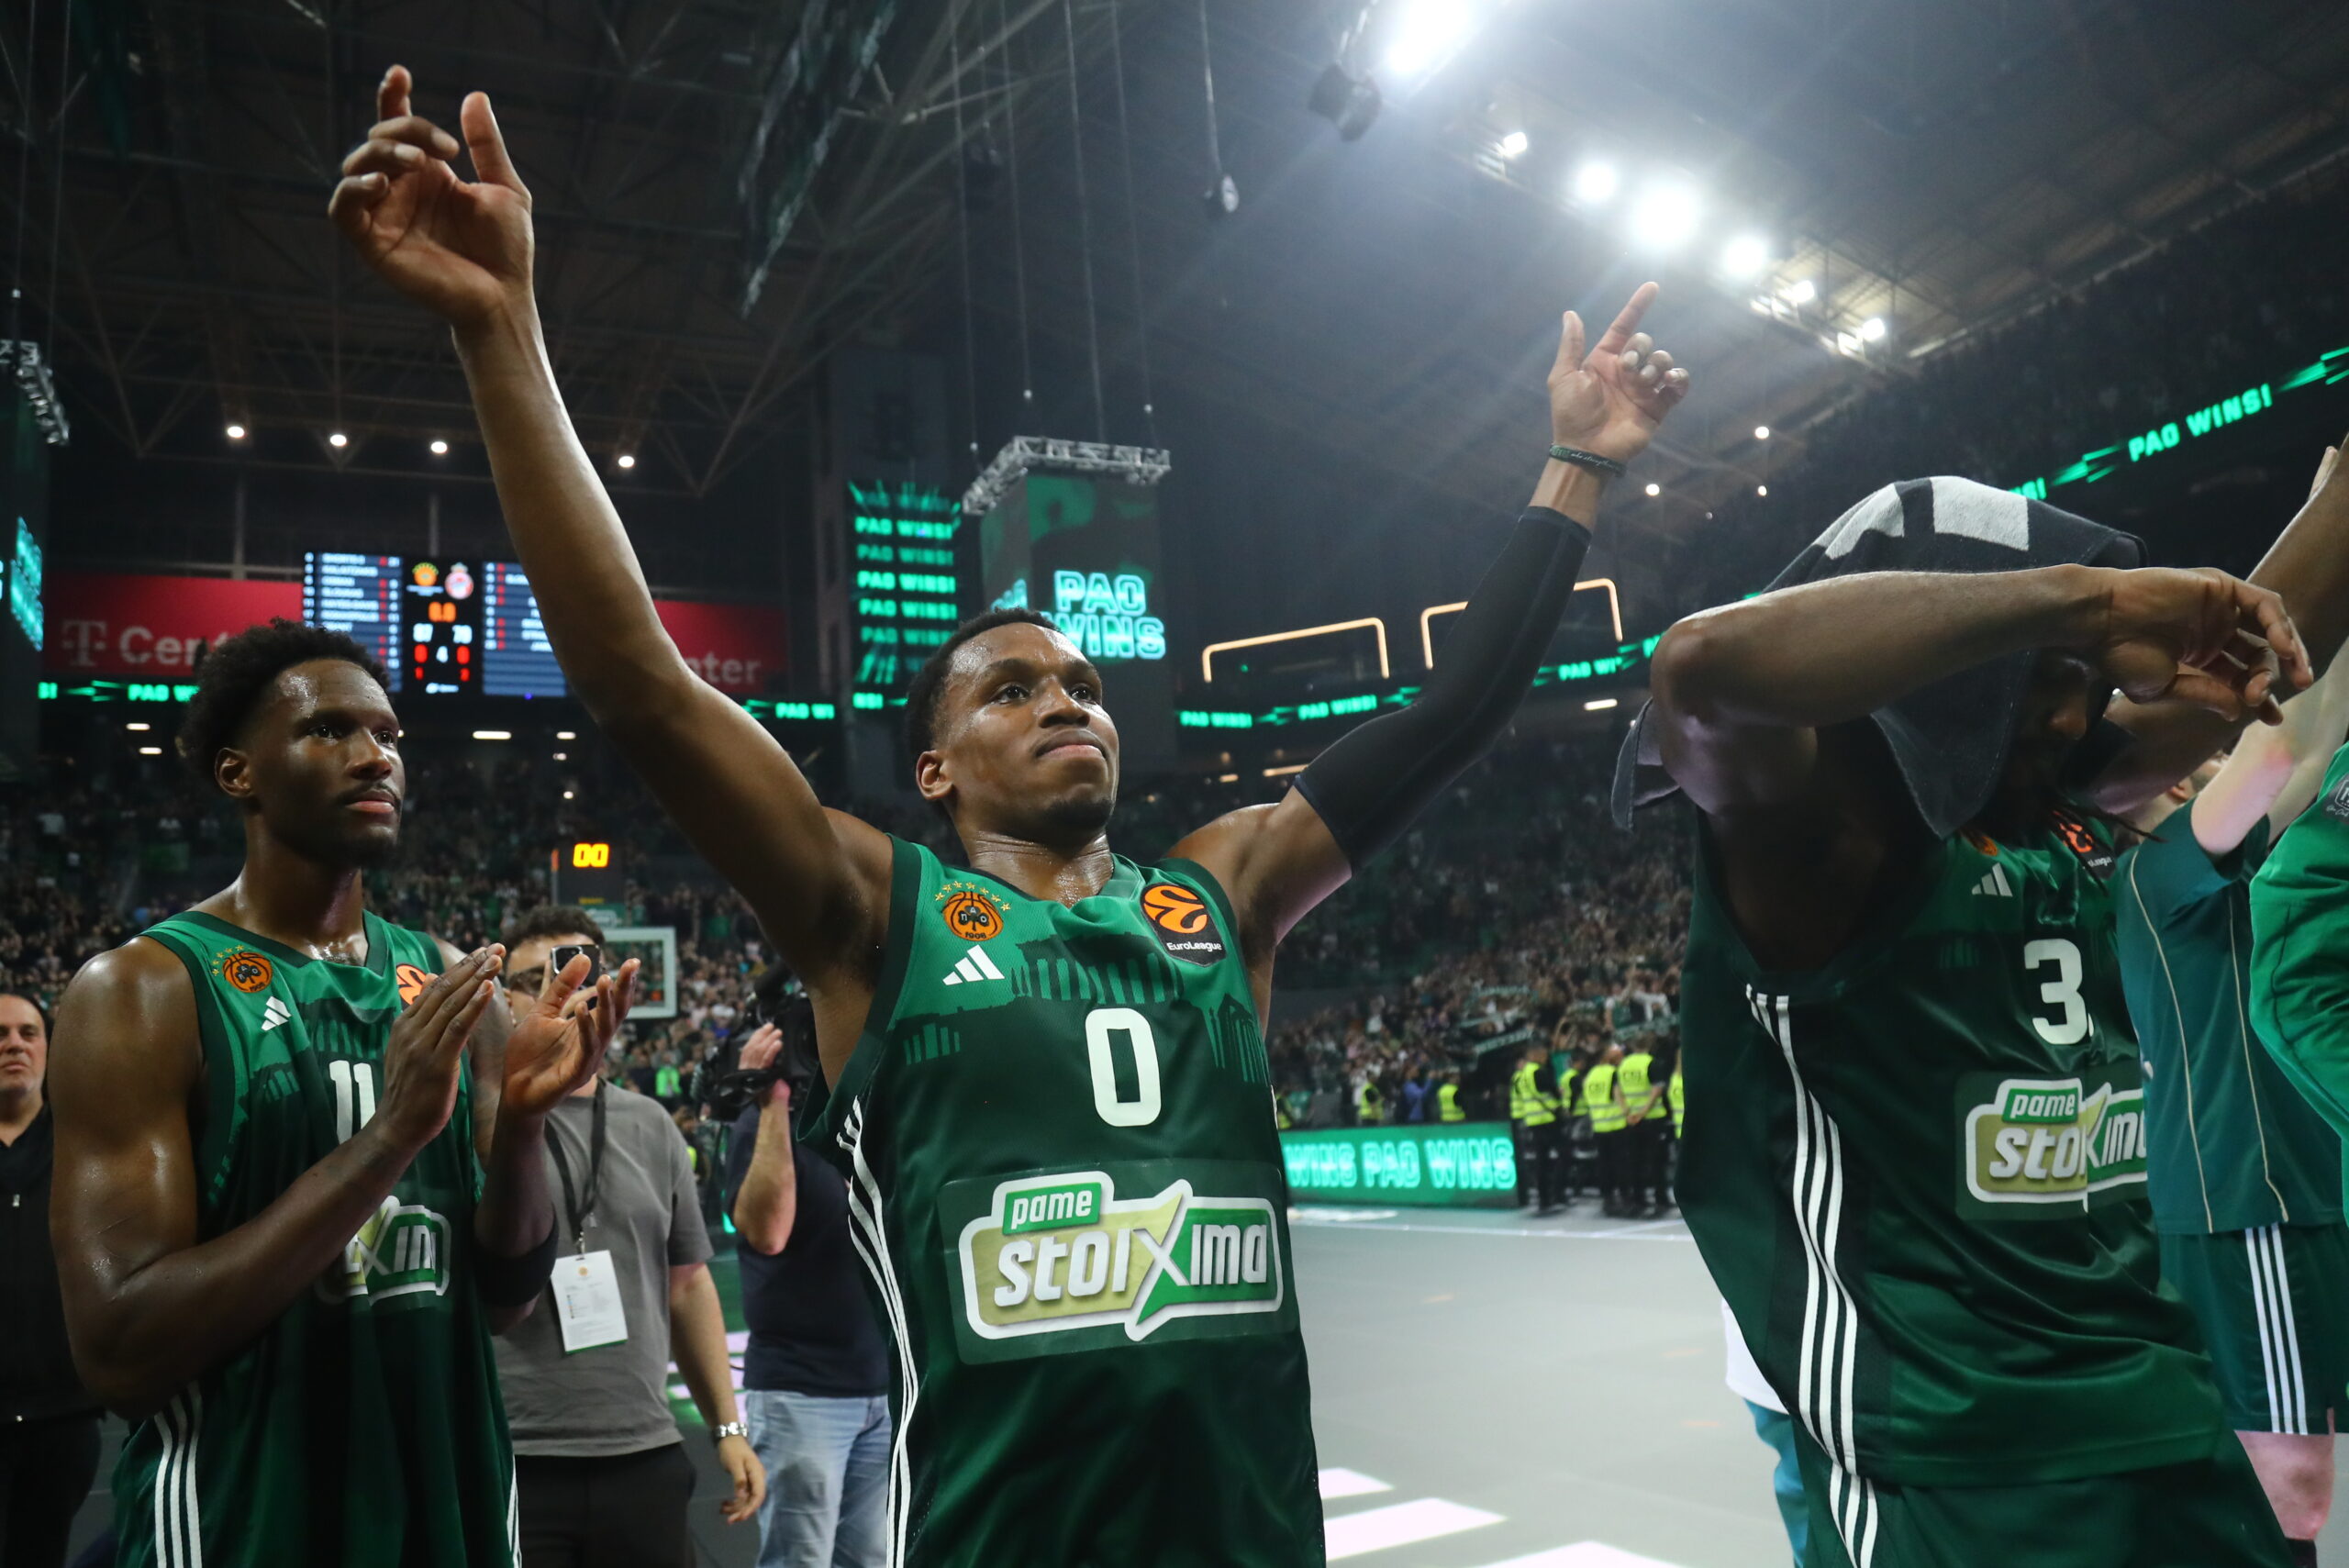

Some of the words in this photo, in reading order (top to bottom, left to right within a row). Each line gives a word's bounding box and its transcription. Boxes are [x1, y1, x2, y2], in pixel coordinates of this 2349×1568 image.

[2128, 422, 2181, 462] PAO
[854, 516, 893, 535] PAO
[856, 543, 894, 562] PAO
[857, 570, 896, 590] PAO
[1053, 570, 1146, 617] PAO
[859, 598, 897, 617] PAO
[861, 626, 898, 643] PAO
[573, 842, 610, 868] 00
[1166, 941, 1223, 952] EuroLeague
[2024, 938, 2092, 1045] 3
[1085, 1007, 1162, 1127] 0
[328, 1060, 376, 1145] 11
[2009, 1094, 2076, 1119] pame
[1285, 1143, 1357, 1188] WINS
[1362, 1140, 1421, 1188] PAO
[1425, 1137, 1518, 1190] WINS
[1010, 1189, 1093, 1230] pame
